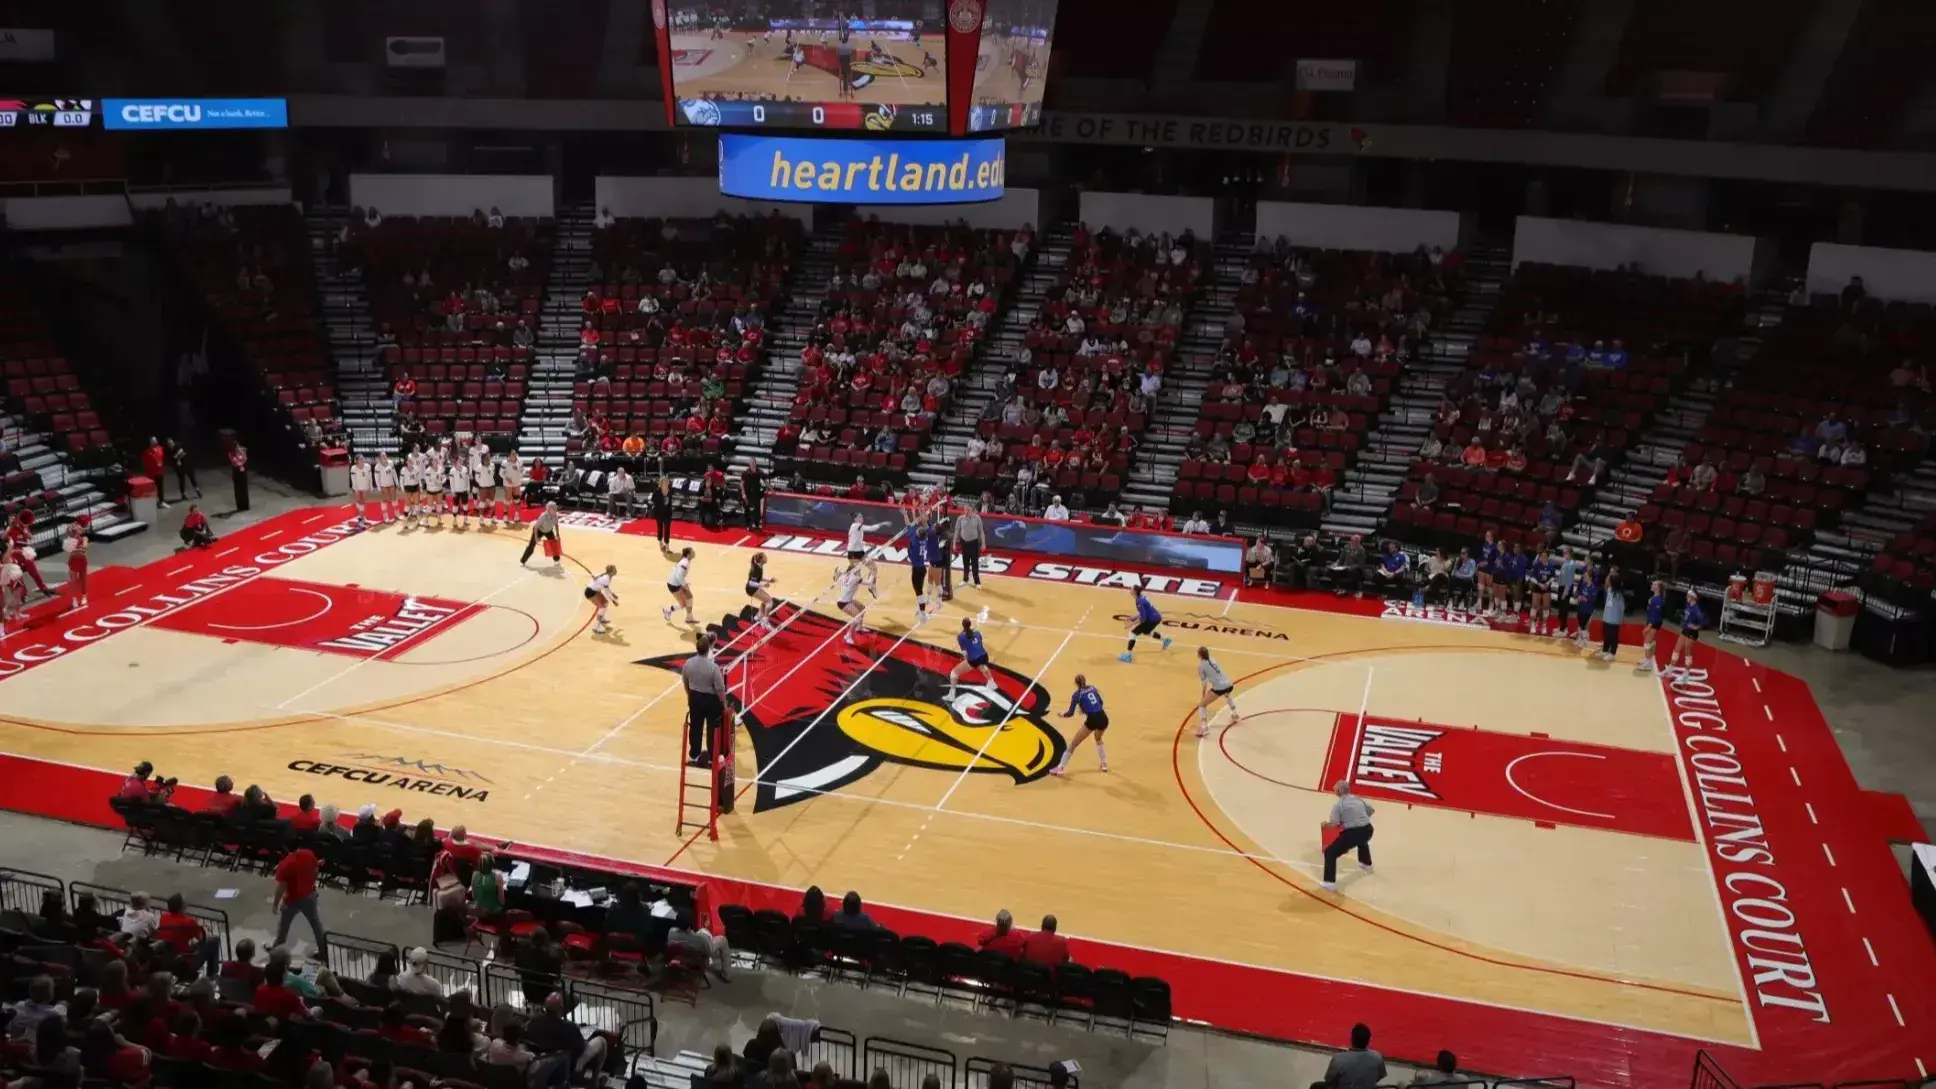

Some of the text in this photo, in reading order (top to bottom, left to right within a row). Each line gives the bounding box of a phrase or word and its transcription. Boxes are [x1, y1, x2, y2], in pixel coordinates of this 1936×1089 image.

[28, 113, 47, 125] BLK
[63, 113, 83, 124] 0.0
[121, 104, 201, 123] CEFCU
[753, 105, 933, 126] 0 0 1:15
[1077, 118, 1115, 138] OF
[1128, 120, 1178, 142] THE
[1189, 122, 1332, 148] REDBIRDS
[1029, 562, 1221, 597] STATE
[64, 565, 262, 642] COLLINS
[1380, 607, 1490, 626] ARENA
[316, 594, 457, 651] VALLEY
[348, 614, 386, 631] THE
[1112, 614, 1290, 641] CCU ARENA
[1087, 692, 1098, 705] 9
[1355, 724, 1446, 799] VALLEY
[1423, 752, 1443, 774] THE
[287, 760, 490, 803] CEFCU ARENA
[1667, 667, 1831, 1024] DOUG COLLINS COURT
